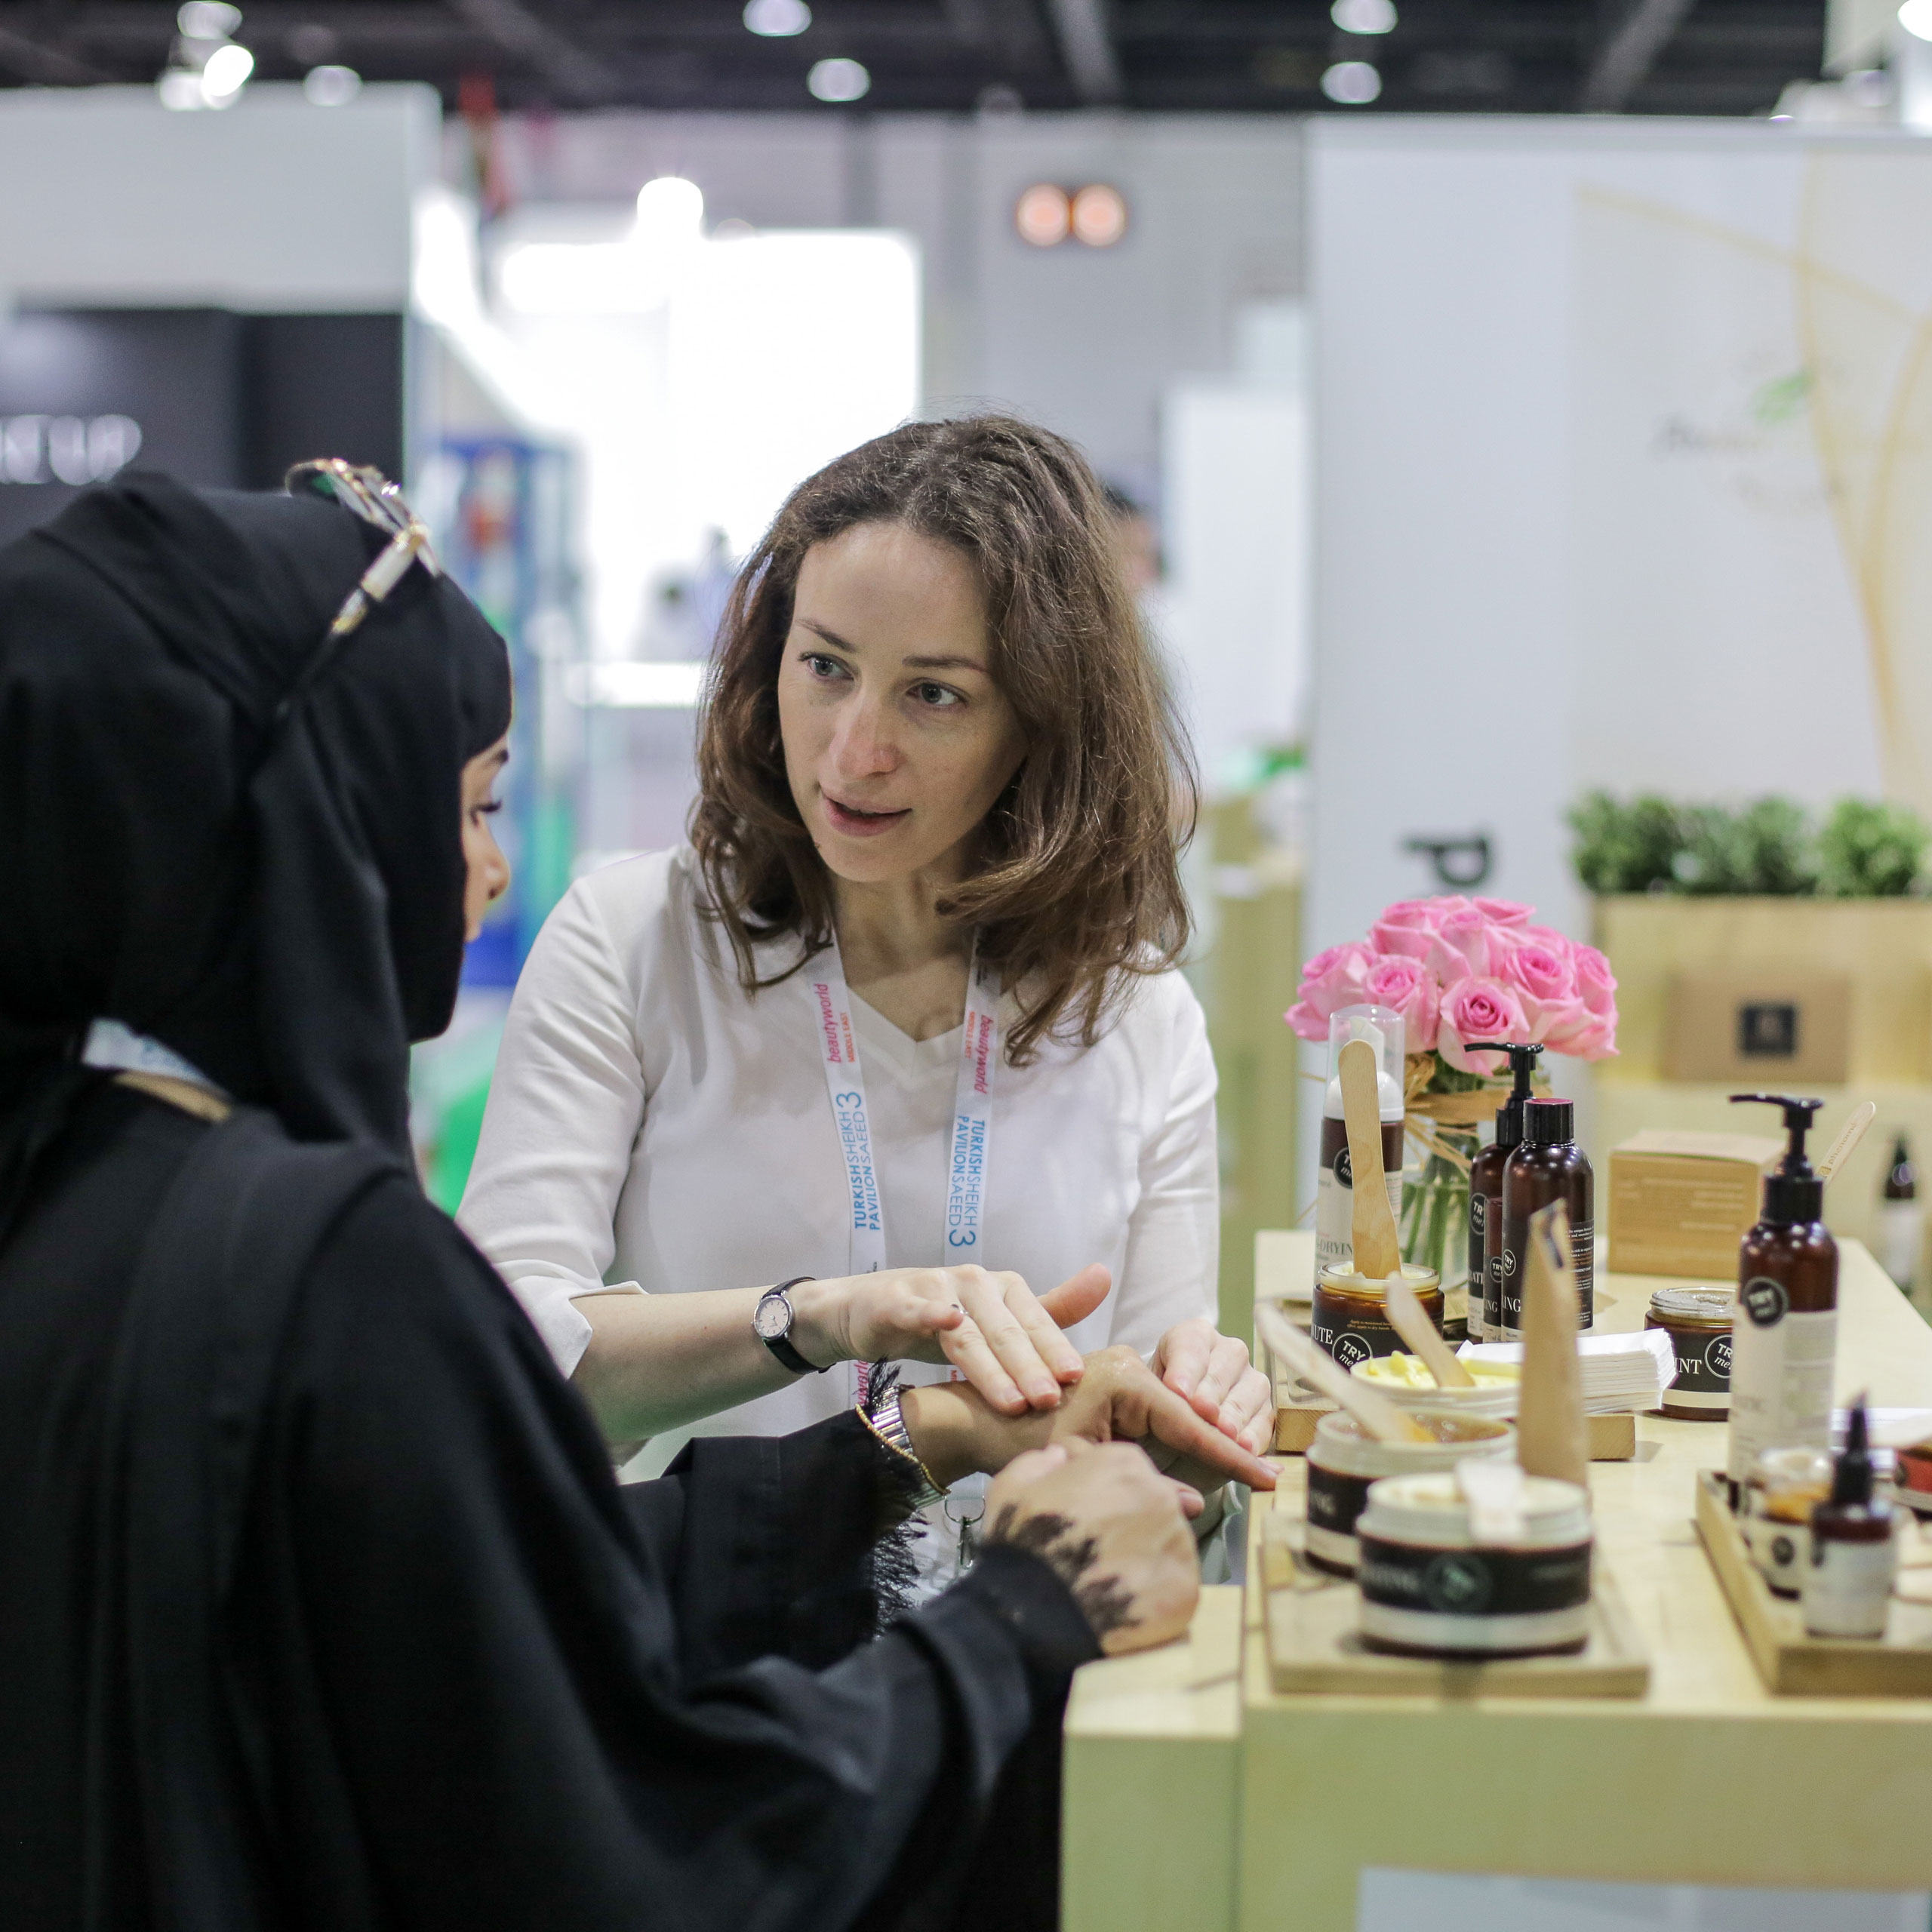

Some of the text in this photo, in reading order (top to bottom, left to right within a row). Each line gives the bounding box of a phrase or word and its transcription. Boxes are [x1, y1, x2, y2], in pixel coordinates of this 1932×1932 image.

[814, 983, 841, 1063] beautyworld
[974, 1014, 994, 1094] beautyworld
[835, 1092, 861, 1108] 3
[1473, 1201, 1484, 1216] TR
[949, 1229, 976, 1247] 3
[1343, 1340, 1365, 1361] TRY
[1718, 1343, 1733, 1358] TR
